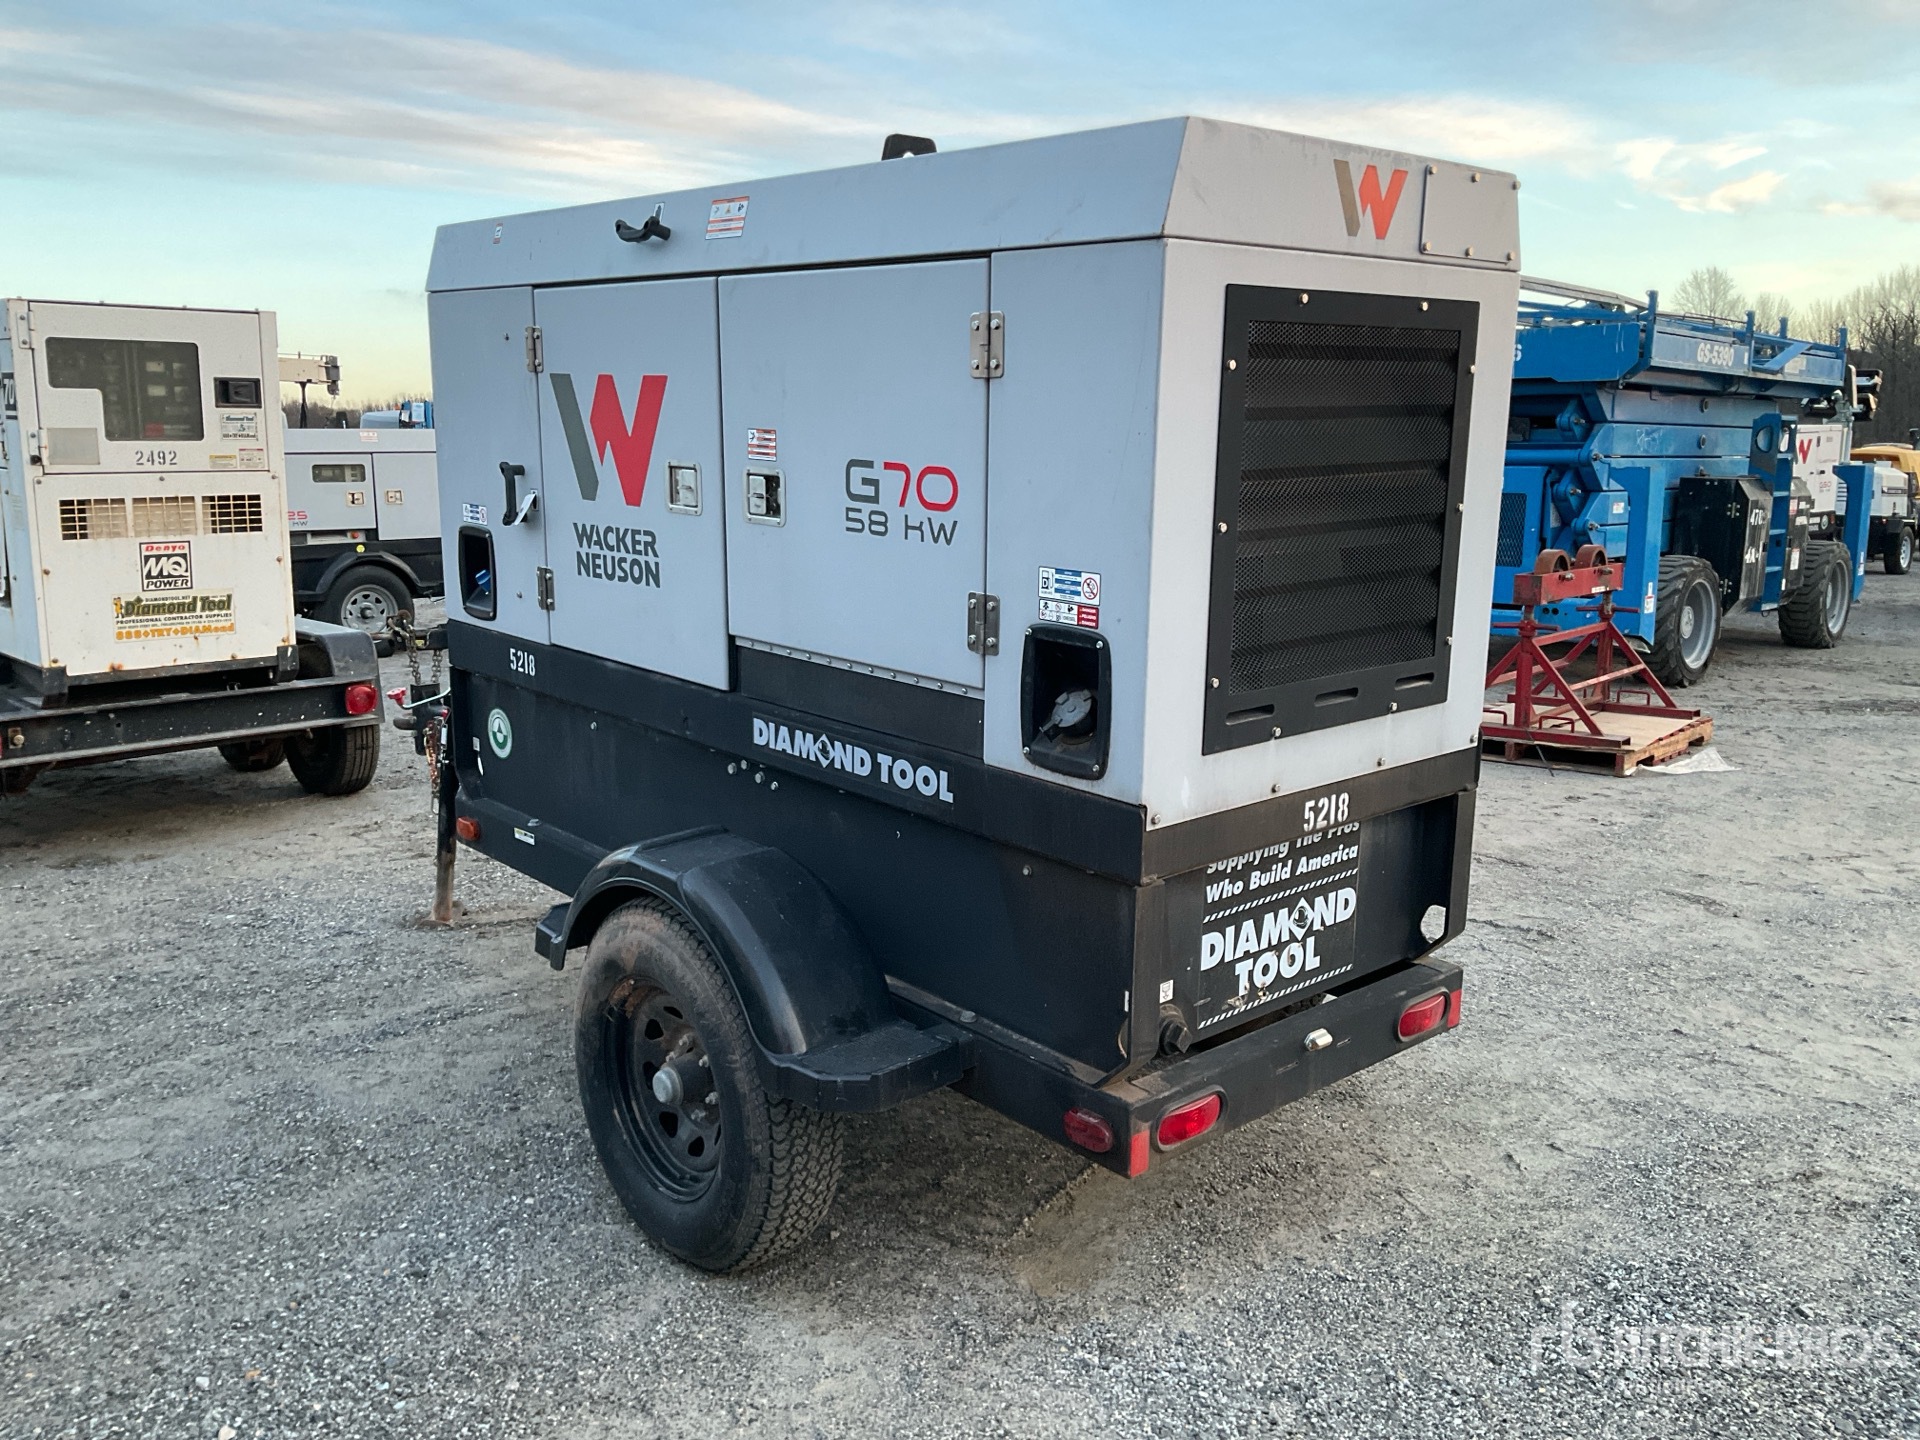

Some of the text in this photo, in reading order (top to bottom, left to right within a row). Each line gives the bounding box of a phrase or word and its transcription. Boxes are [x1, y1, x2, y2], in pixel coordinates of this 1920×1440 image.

[1697, 342, 1735, 367] GS-5390
[135, 450, 178, 466] 2492
[845, 458, 959, 512] G70
[845, 506, 889, 537] 58
[145, 543, 186, 553] Denyo
[572, 522, 659, 559] WACKER
[144, 556, 189, 577] MQ
[576, 550, 661, 589] NEUSON
[144, 594, 191, 603] DIAMONDTOOL.NET
[146, 578, 189, 590] POWER
[115, 616, 162, 625] PROFESSIONAL
[163, 614, 203, 622] CONTRACTOR
[124, 593, 233, 618] Diamond Tool
[510, 648, 536, 676] 5218
[753, 717, 954, 804] DIAMOND TOOL
[1303, 792, 1350, 832] 5218
[1206, 844, 1359, 904] Who Build America
[1200, 887, 1357, 971] DIAMOND
[1234, 935, 1321, 996] TOOL
